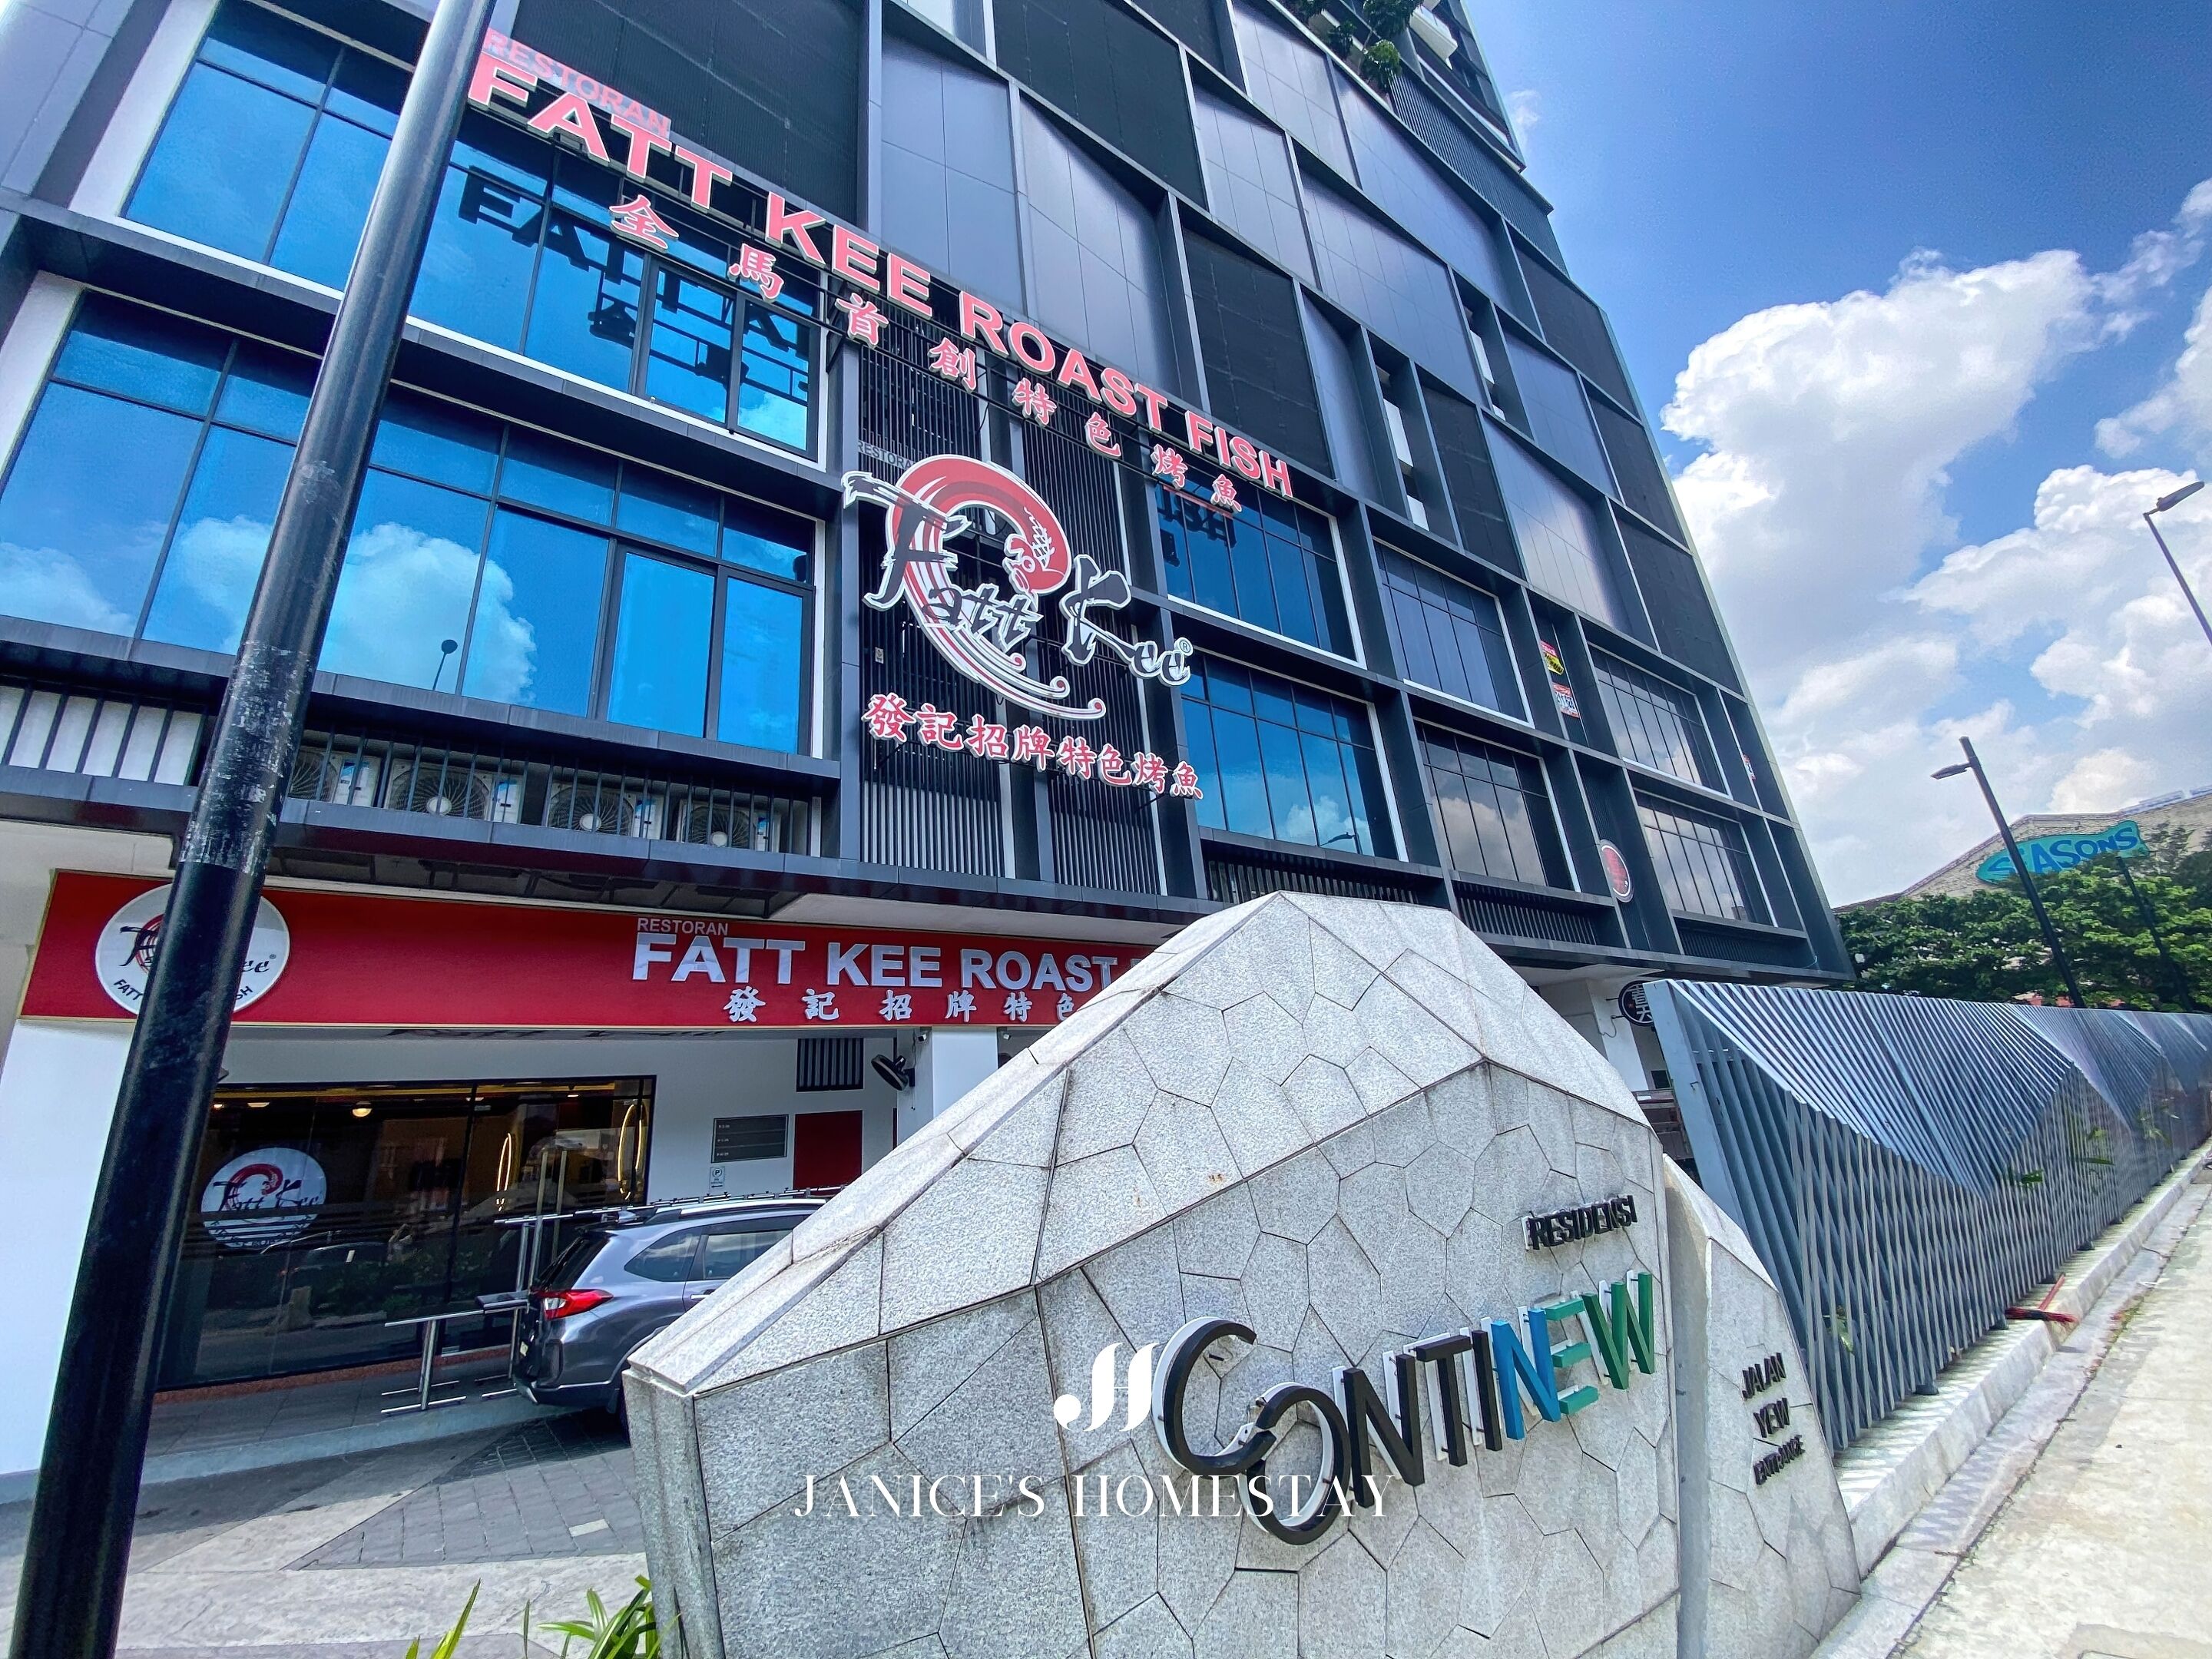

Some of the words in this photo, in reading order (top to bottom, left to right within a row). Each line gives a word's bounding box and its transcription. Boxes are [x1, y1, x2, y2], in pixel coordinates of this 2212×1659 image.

[484, 28, 672, 137] RESTORAN
[467, 51, 733, 211] FATT
[765, 190, 933, 319] KEE
[959, 288, 1169, 435] ROAST
[1184, 409, 1295, 502] FISH
[859, 440, 916, 470] RESTORA
[862, 691, 1204, 802] 發記招牌特色烤魚
[1988, 826, 2138, 874] SASONS
[637, 917, 729, 936] RESTORAN
[631, 933, 806, 985] FATT
[826, 941, 942, 988] KEE
[960, 949, 1118, 992] ROAST
[114, 979, 144, 1001] FATT
[1522, 1194, 1638, 1250] RESIDENSI
[1741, 1352, 1786, 1399] JALAN
